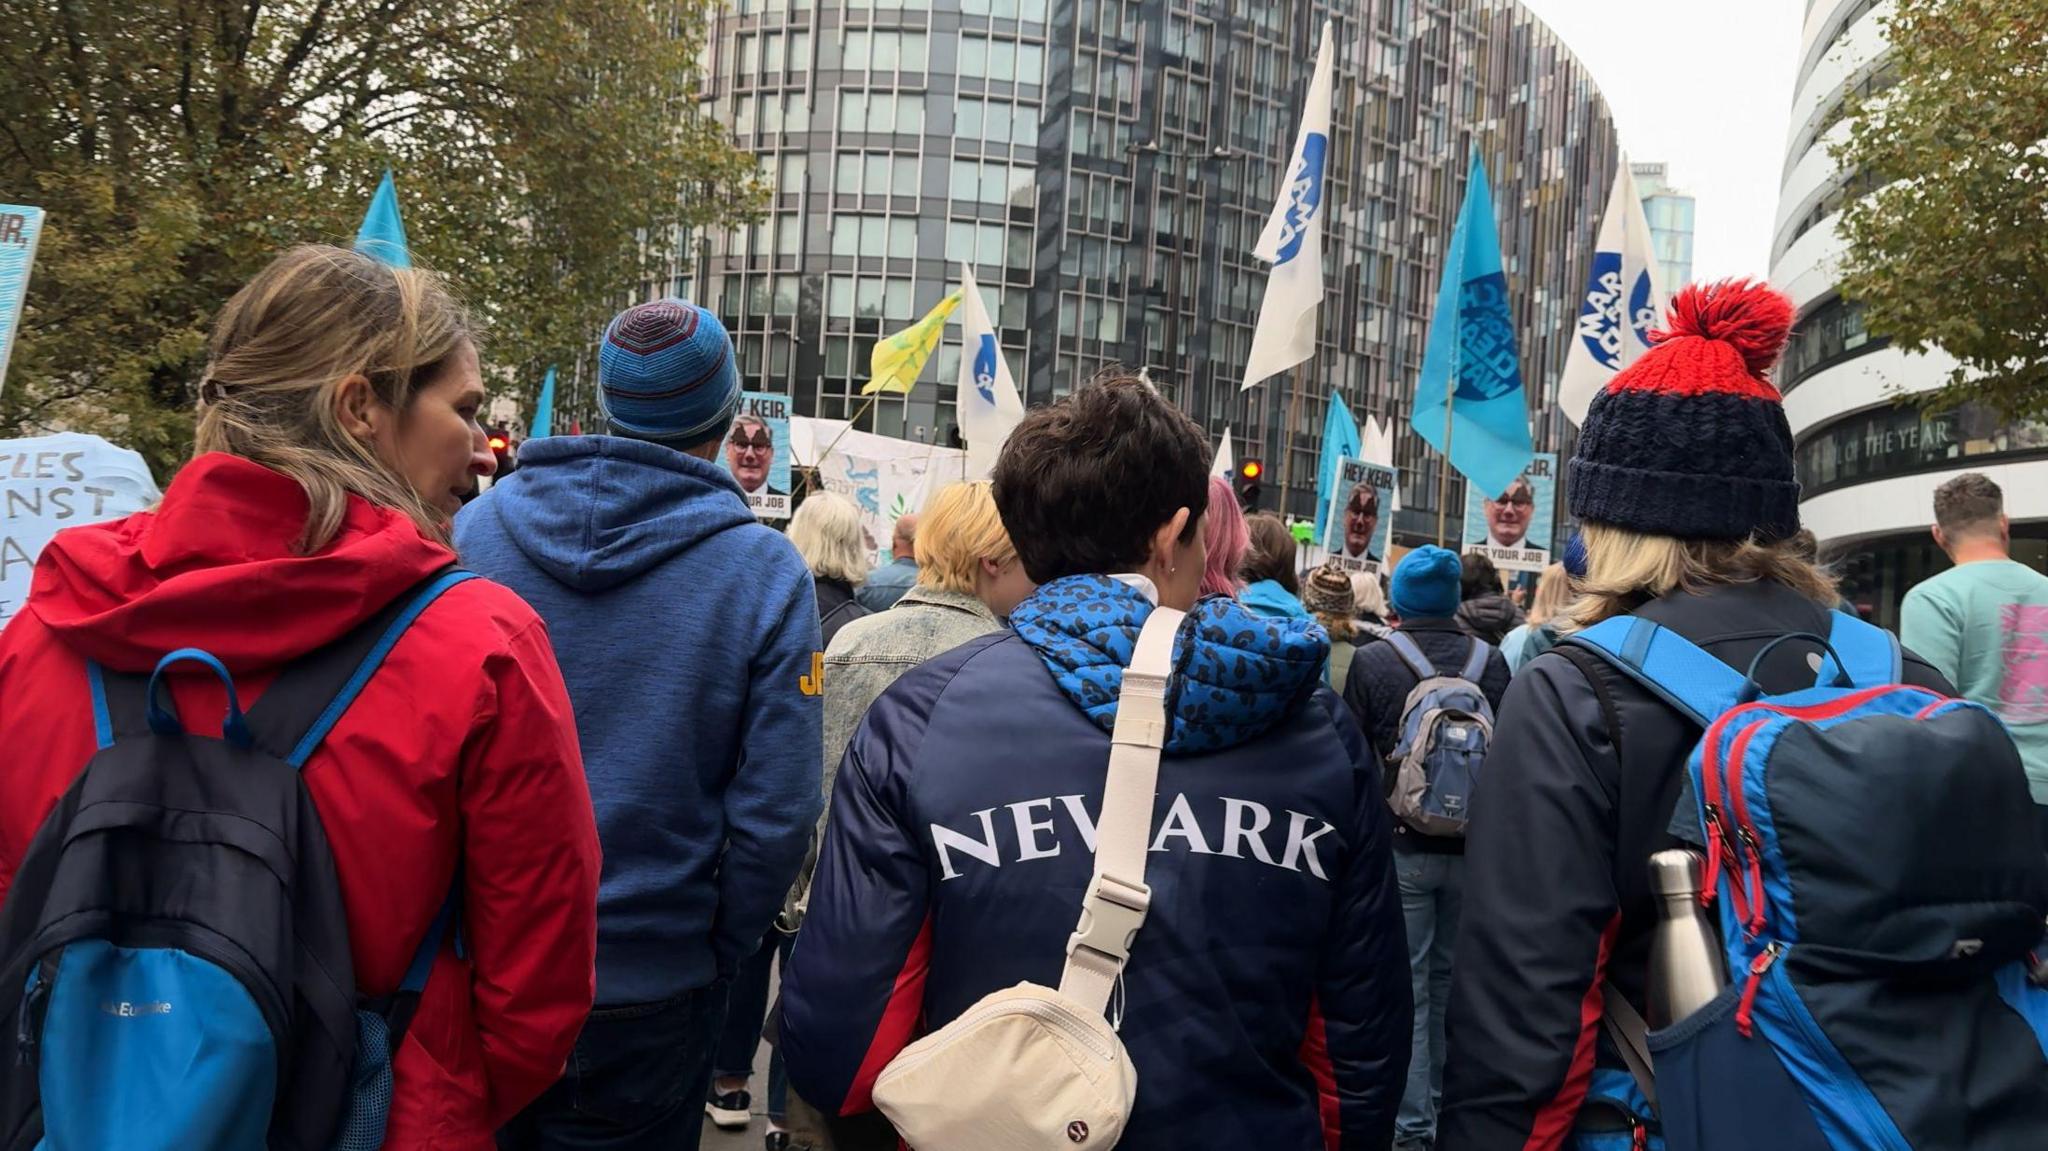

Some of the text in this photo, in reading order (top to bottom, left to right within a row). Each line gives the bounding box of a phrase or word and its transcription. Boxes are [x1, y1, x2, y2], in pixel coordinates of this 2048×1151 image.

[750, 398, 789, 423] KEIR,
[1865, 431, 1894, 456] THE
[1899, 421, 1949, 449] YEAR
[1343, 463, 1367, 482] HEY
[765, 497, 784, 509] JOB
[1491, 548, 1520, 561] YOUR
[1522, 552, 1543, 563] JOB
